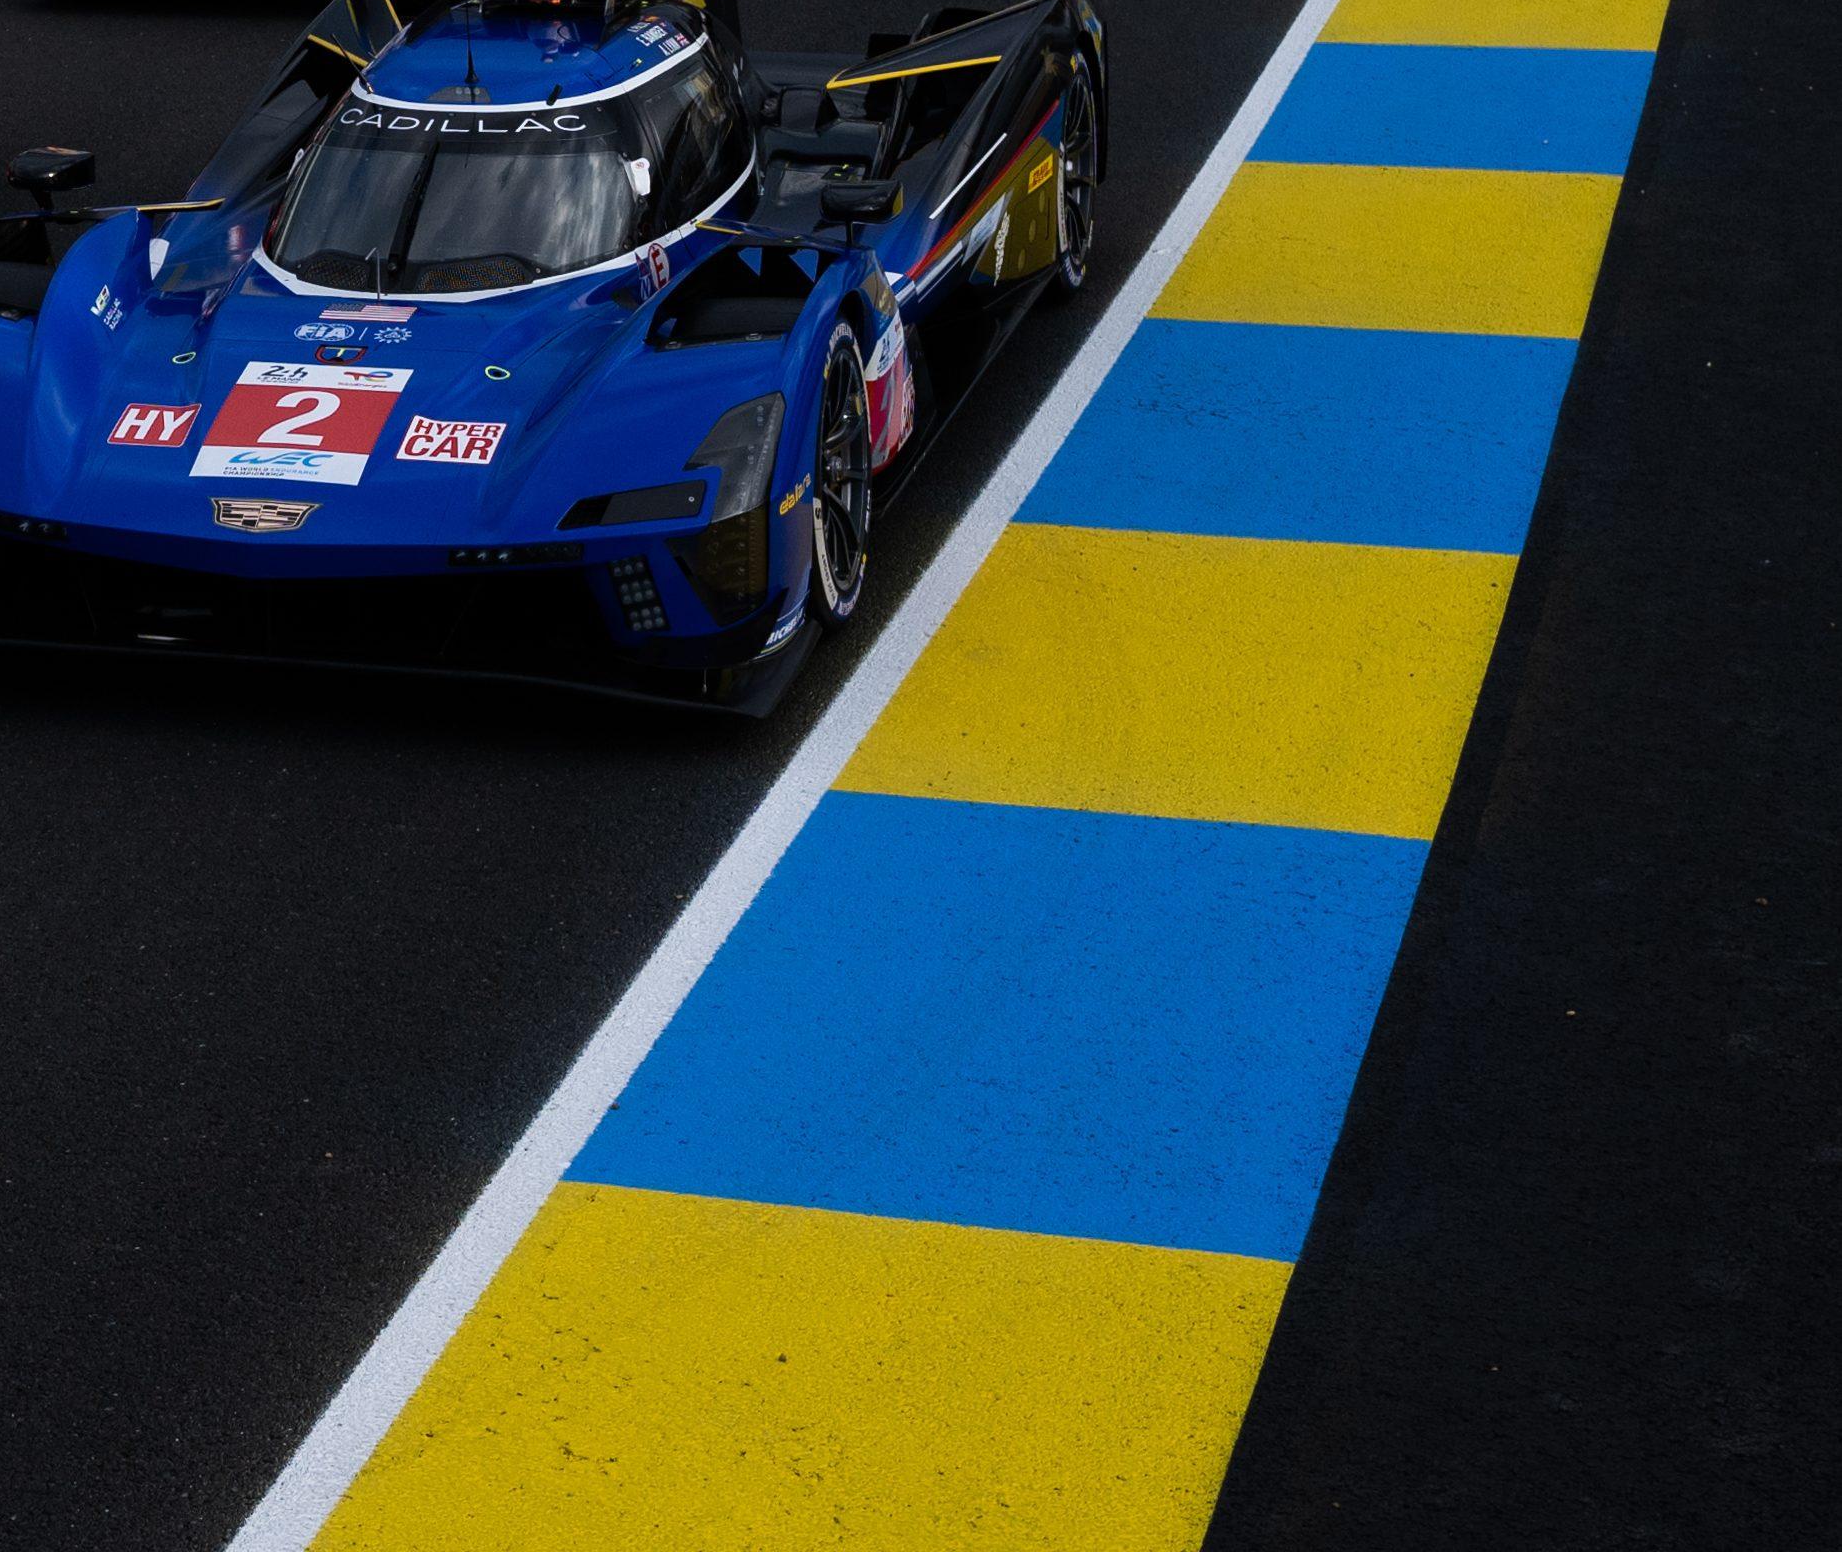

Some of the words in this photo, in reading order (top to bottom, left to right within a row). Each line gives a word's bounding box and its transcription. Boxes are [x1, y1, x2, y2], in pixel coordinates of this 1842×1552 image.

[339, 107, 588, 134] CADILLAC
[298, 323, 353, 340] FIA
[113, 408, 195, 442] HY
[256, 390, 342, 447] 2
[414, 419, 501, 438] HYPER
[231, 451, 335, 468] WEC
[403, 434, 497, 460] CAR
